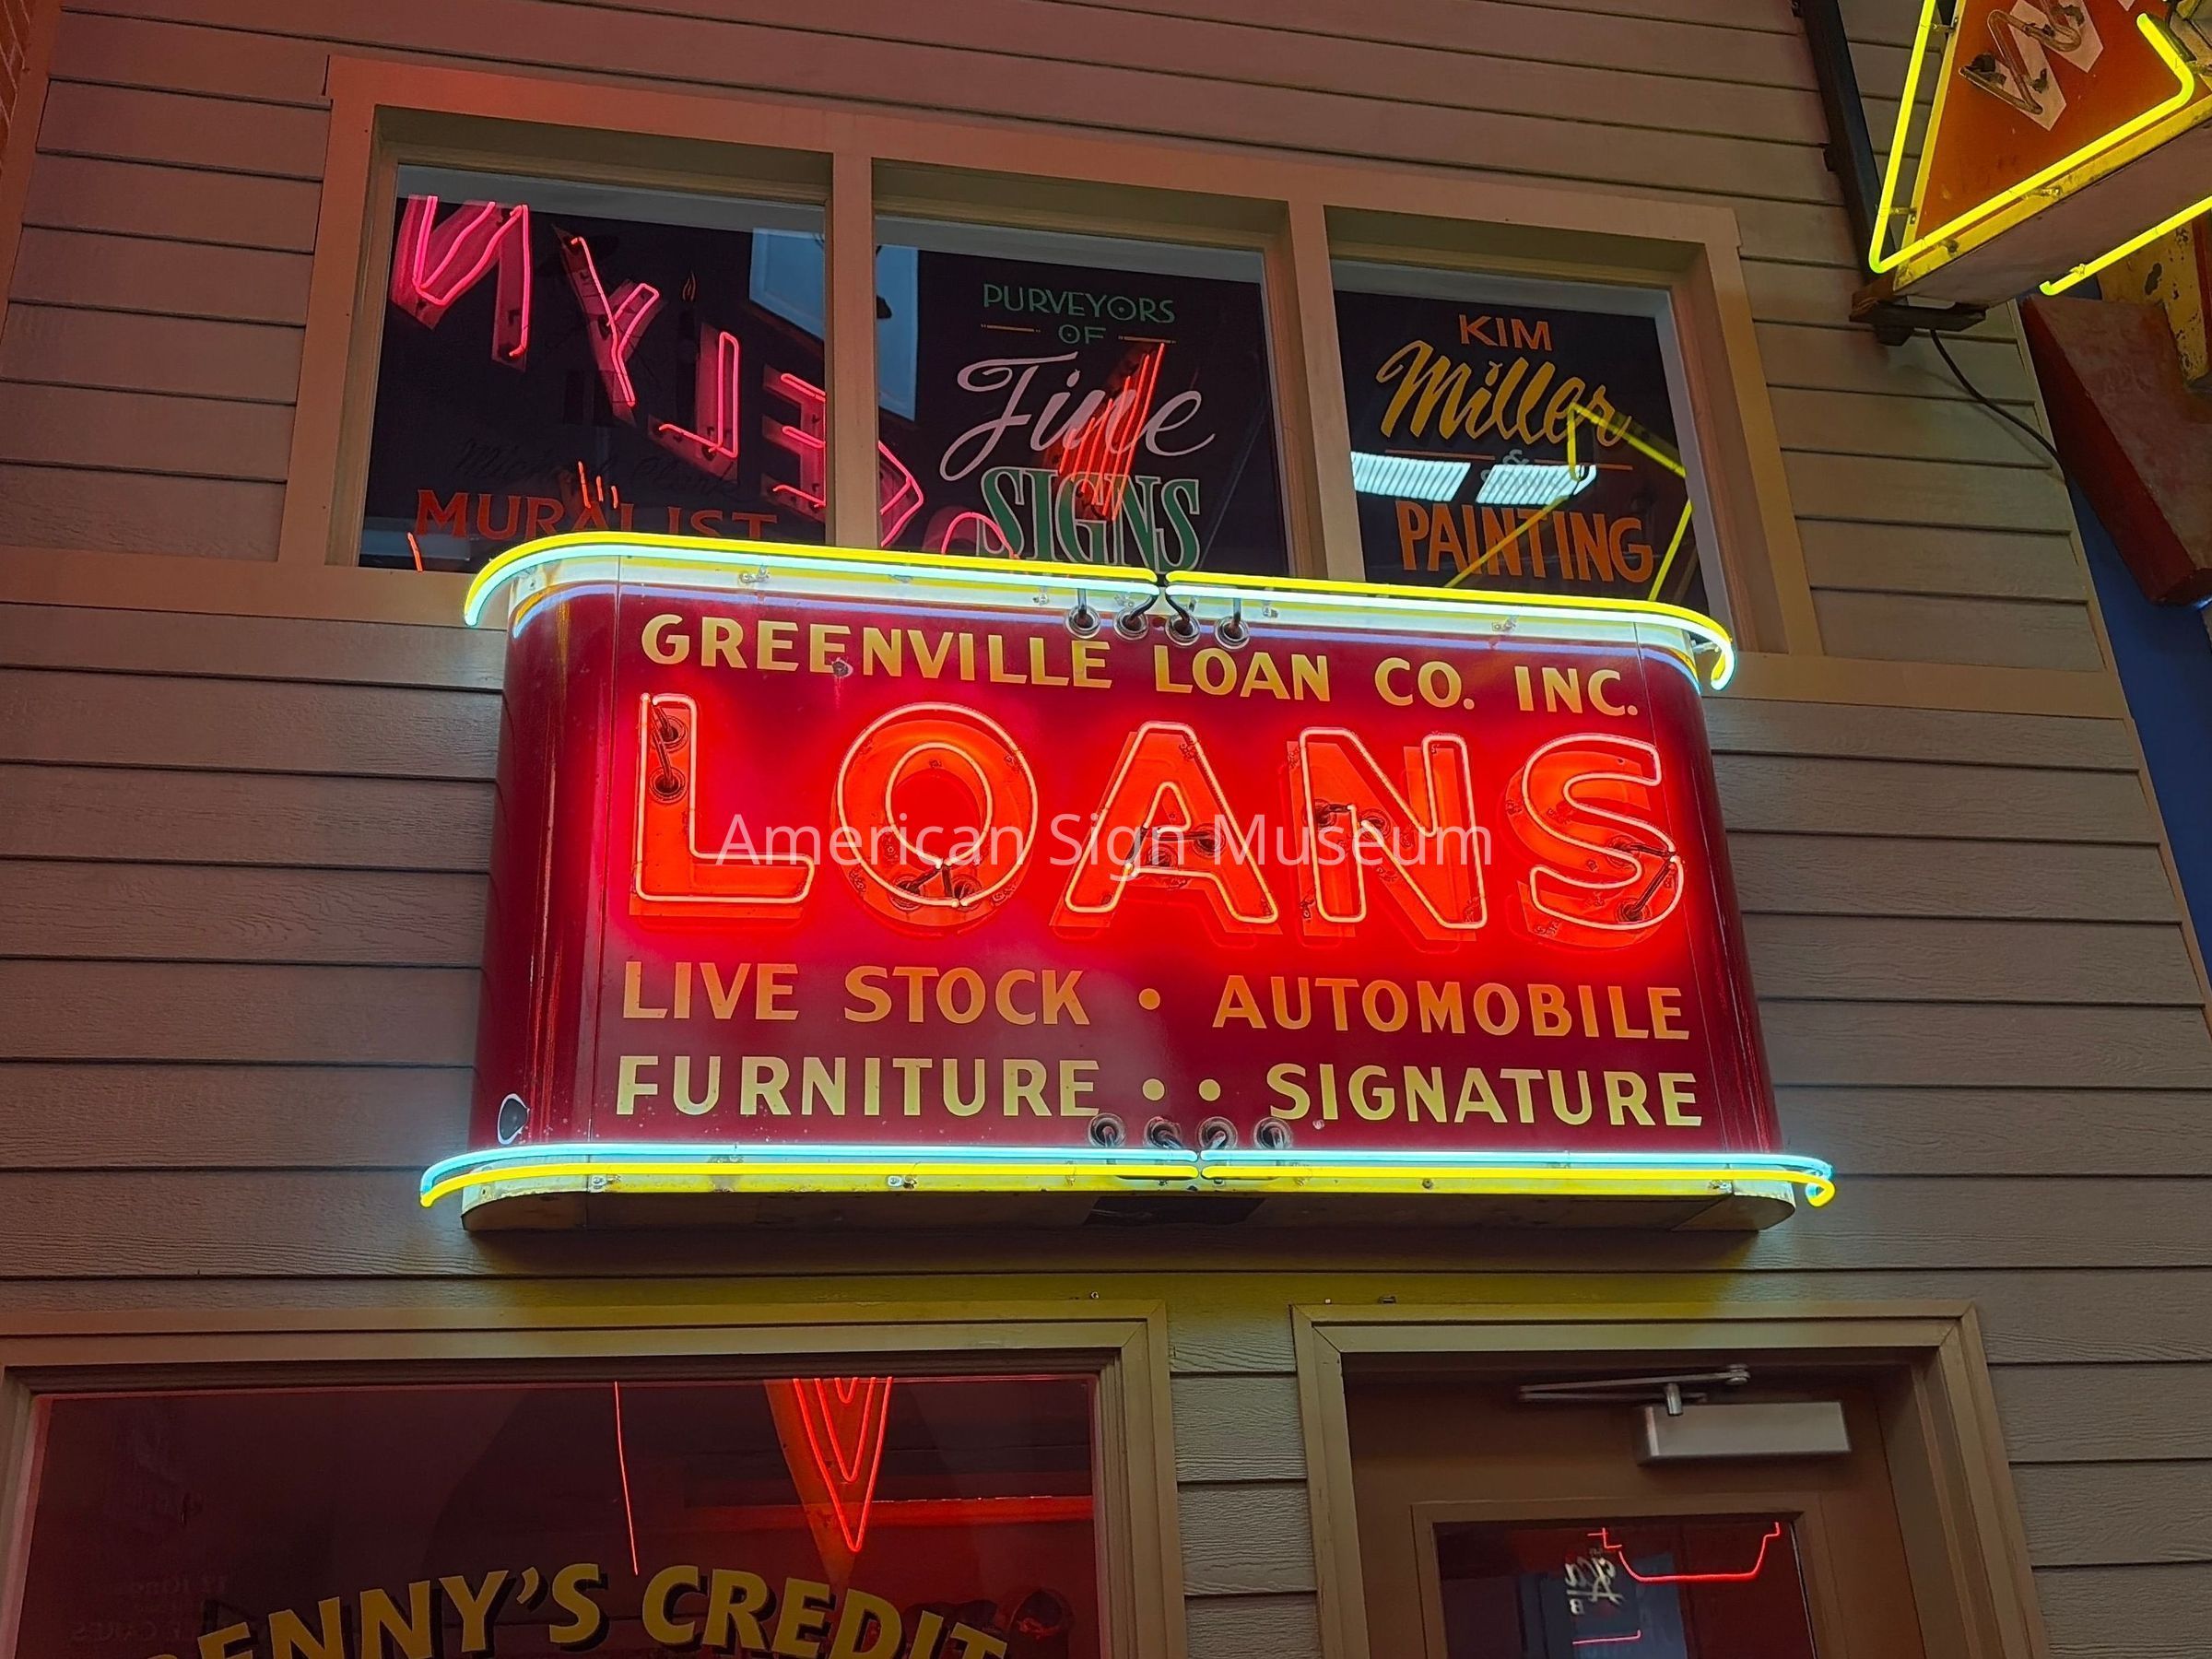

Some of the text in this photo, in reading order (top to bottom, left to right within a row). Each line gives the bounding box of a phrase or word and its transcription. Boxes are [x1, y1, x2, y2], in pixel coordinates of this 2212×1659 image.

[982, 283, 1176, 324] PURVEYORS
[1058, 324, 1107, 345] OF
[1458, 313, 1553, 352] KIM
[939, 351, 1216, 481] Fine
[1375, 339, 1633, 448] Miller
[975, 466, 1200, 573] SIGNS
[1394, 500, 1654, 583] PAINTING
[641, 614, 1639, 716] GREENVILLE LOAN CO. INC.
[629, 692, 1686, 947] LOANS
[622, 960, 1690, 1041] LIVE STOCK AUTOMOBILE
[615, 1055, 1704, 1127] FURNITURE SIGNATURE
